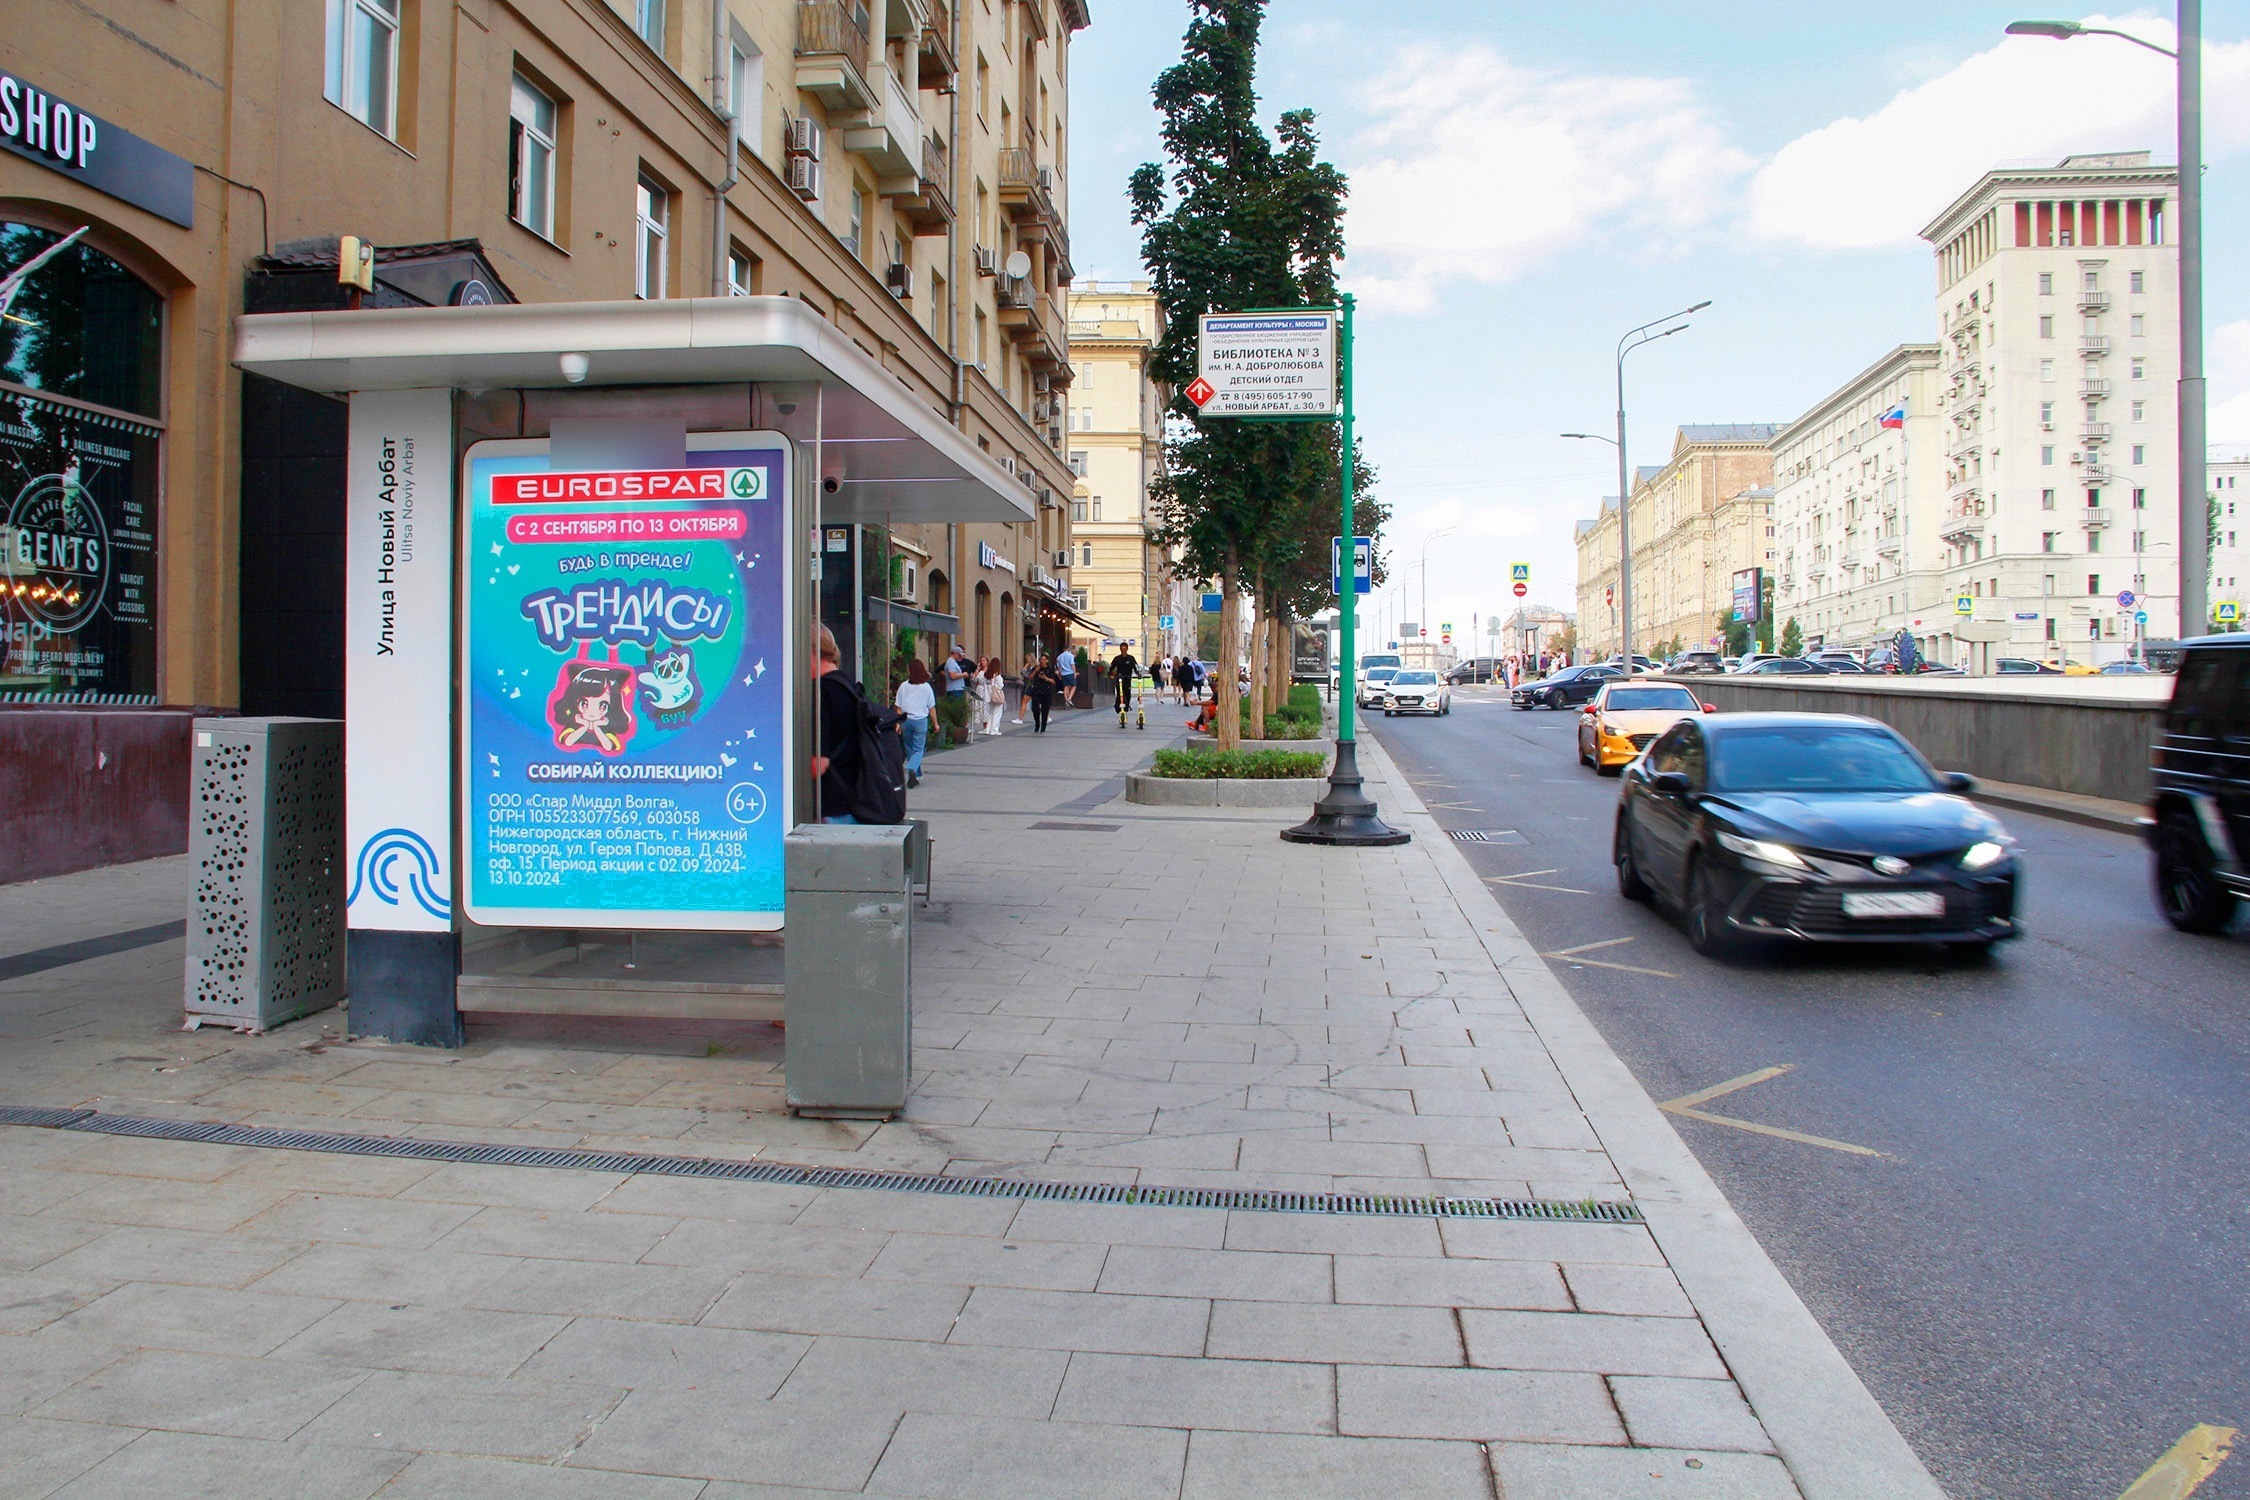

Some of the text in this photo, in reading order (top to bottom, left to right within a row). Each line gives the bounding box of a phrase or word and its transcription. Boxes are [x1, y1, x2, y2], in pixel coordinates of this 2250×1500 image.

[0, 76, 97, 168] SHOP
[1209, 322, 1254, 330] ДЕПАРТАМЕНТ
[1255, 321, 1288, 329] КУЛЬТУРЫ
[1295, 320, 1324, 328] МОСКВЫ
[1213, 347, 1320, 359] БИБЛИОТЕКА № 3
[1245, 361, 1324, 371] ДОБРОЛЮБОВА
[1229, 375, 1303, 385] ДЕТСКИЙ ОТДЕЛ
[1233, 391, 1313, 401] 8 (495) 605-17-90
[1225, 401, 1259, 411] НОВЫЙ
[1302, 402, 1325, 411] 30/9
[73, 439, 131, 461] BALINESE MASSAGE
[516, 474, 722, 498] EUROSPAR
[123, 501, 144, 514] FACIAL
[401, 436, 416, 562] Ulitsa Noviy Arbat
[125, 515, 141, 527] CARE
[515, 517, 738, 537] С 2 СЕНТЯБРЯ ПО 13 ОКТЯБРЯ
[17, 527, 99, 572] GENTS
[377, 437, 398, 656] Улица Новый Арбат
[120, 573, 144, 586] HAIRCUT
[124, 588, 139, 598] WITH
[118, 602, 145, 613] SCISSORS
[528, 586, 723, 642] ТРЕНДИСЫ
[10, 649, 40, 662] PREMIUM
[42, 651, 62, 662] BEARD
[96, 654, 104, 664] BY
[528, 761, 723, 781] СОБИРАЙ КОЛЛЕКЦИЮ!
[489, 793, 679, 811] ООО «Спар Миддл Волга»,
[733, 792, 759, 811] 6+
[489, 809, 700, 826] ОГРН 1055233077569, 603058
[489, 825, 748, 842] Нижегородская область, г. Нижний
[489, 840, 562, 856] Новгород,
[566, 844, 587, 858] ул.
[590, 842, 632, 858] Героя
[636, 842, 695, 856] Попова.
[489, 856, 746, 873] оф. 15. Период акции с 02.09.2024-
[489, 871, 565, 886] 13.10.2024.
